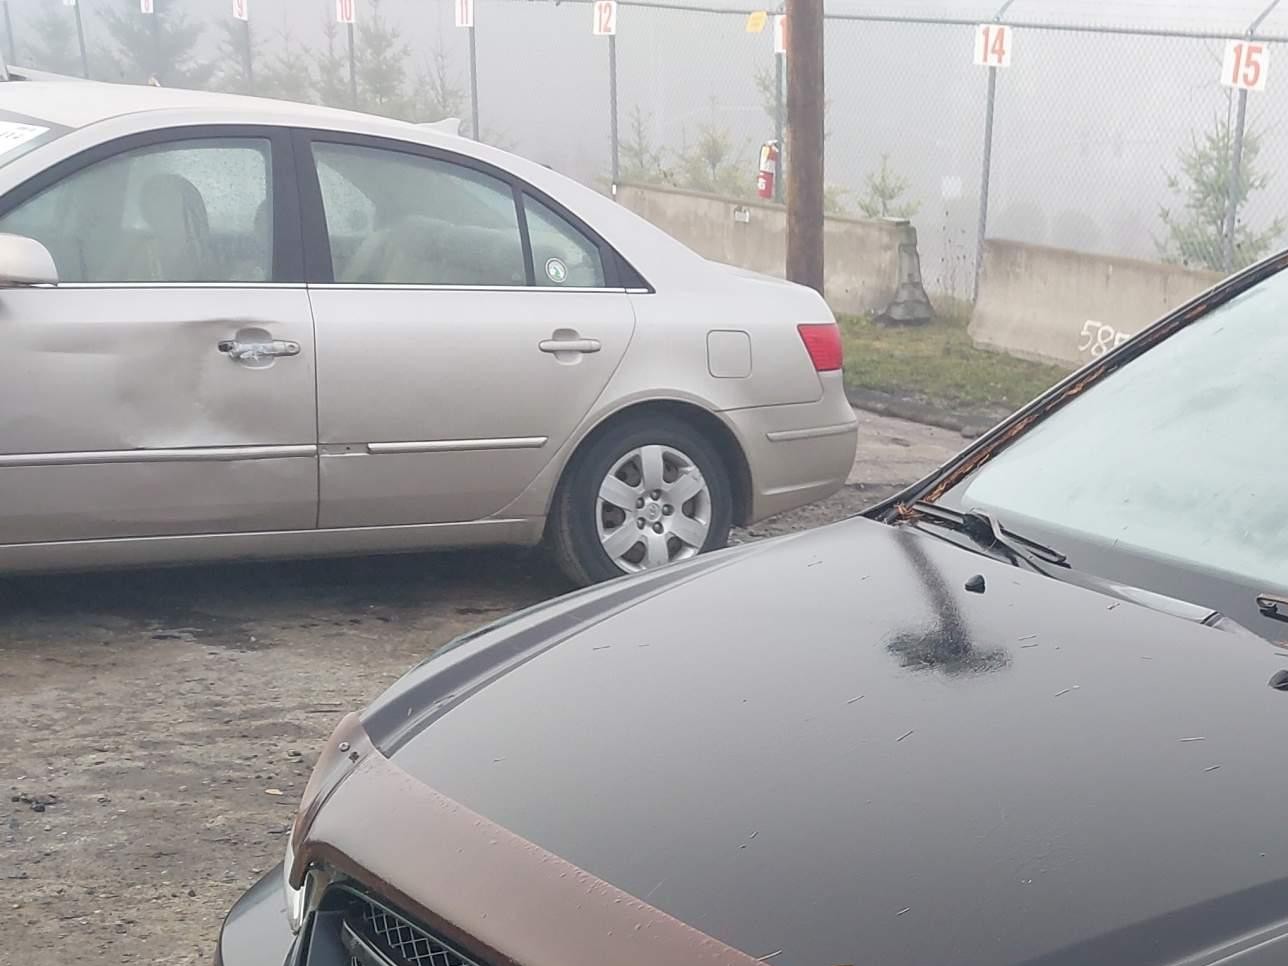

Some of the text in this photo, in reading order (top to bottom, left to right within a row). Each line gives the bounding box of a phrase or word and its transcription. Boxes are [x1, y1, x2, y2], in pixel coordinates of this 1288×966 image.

[598, 2, 611, 33] 12
[982, 26, 1006, 65] 14
[1232, 42, 1263, 87] 15
